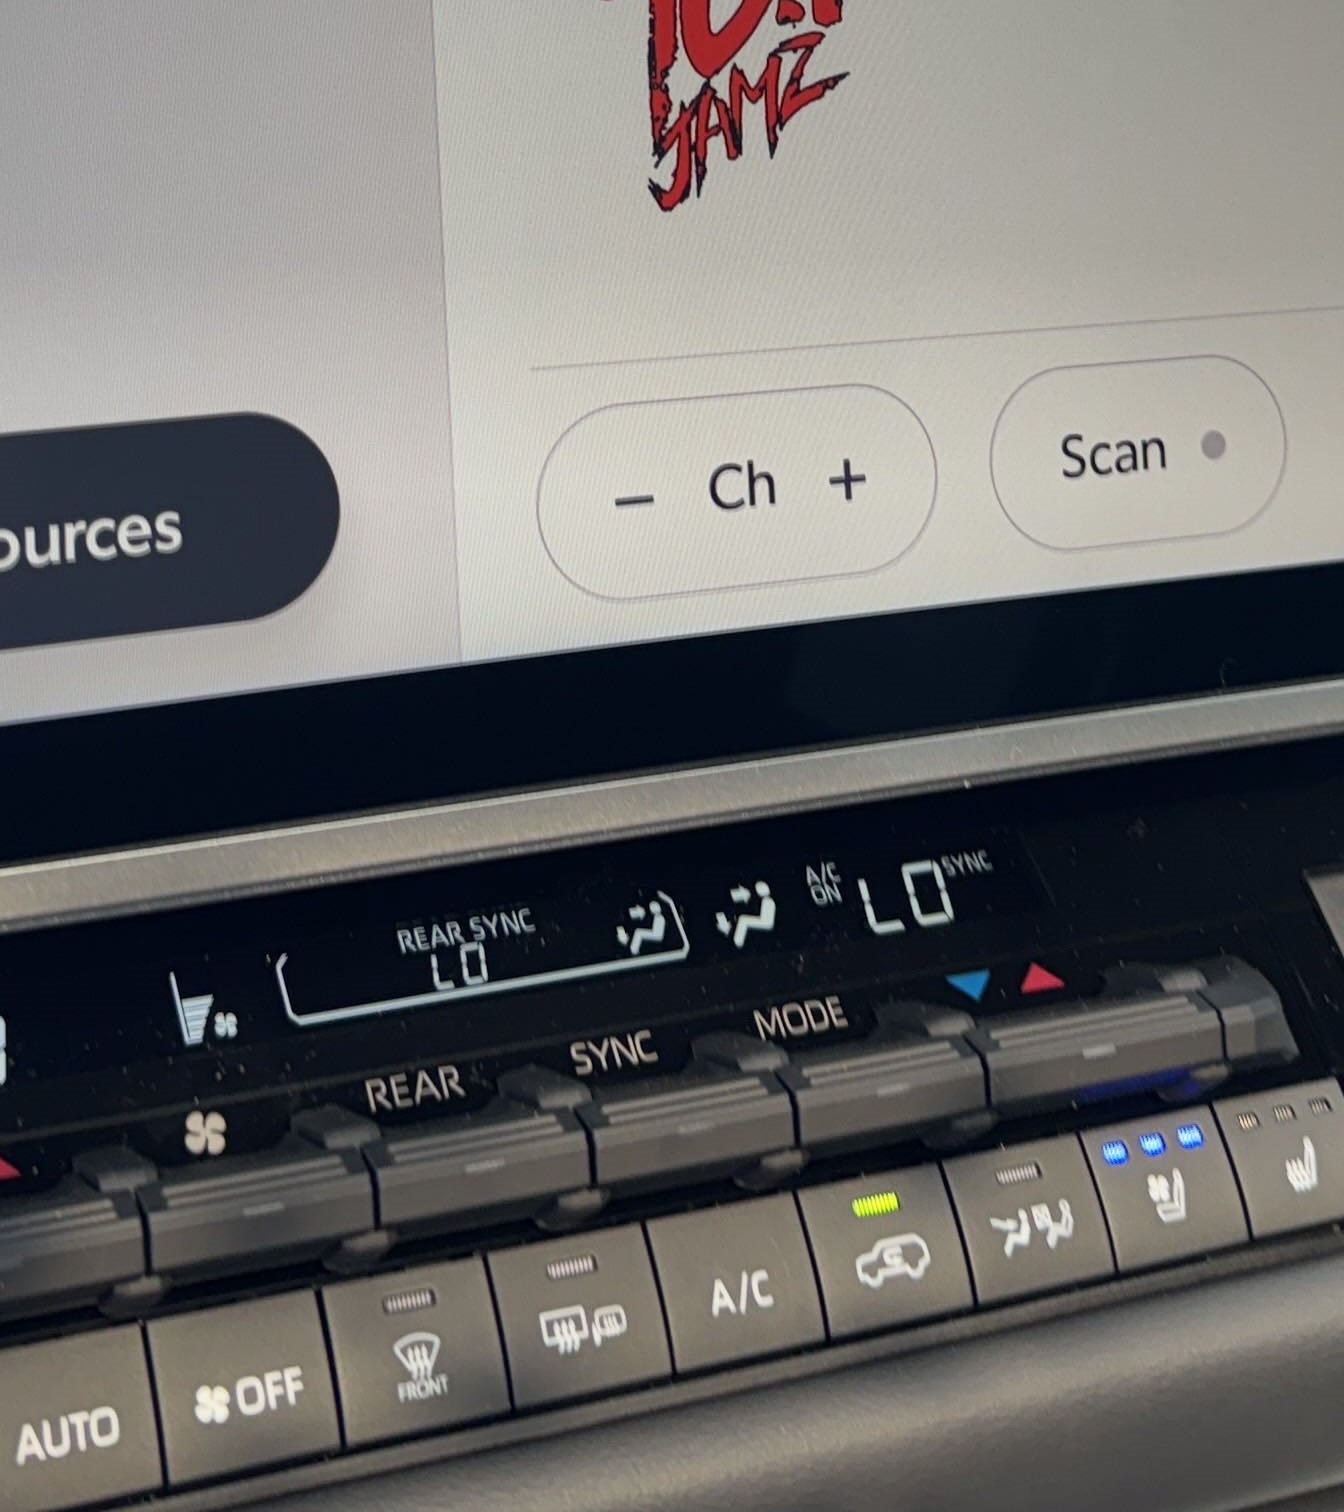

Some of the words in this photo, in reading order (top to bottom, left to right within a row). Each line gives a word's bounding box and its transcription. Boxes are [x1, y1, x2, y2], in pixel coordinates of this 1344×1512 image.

[648, 31, 850, 212] JAMZ
[1060, 426, 1168, 482] Scan
[708, 457, 778, 514] Ch
[806, 861, 842, 886] A/C
[941, 849, 994, 877] SYNC
[811, 882, 843, 907] ON
[858, 859, 955, 935] LO
[397, 920, 464, 955] REAR
[468, 908, 536, 942] SYNC
[431, 941, 489, 991] LO
[753, 995, 849, 1041] MODE
[570, 1030, 660, 1076] SYNC
[365, 1065, 466, 1113] REAR
[710, 1268, 775, 1320] A/C
[236, 1366, 304, 1417] OFF
[397, 1372, 449, 1404] FRONT
[16, 1406, 121, 1466] AUTO
